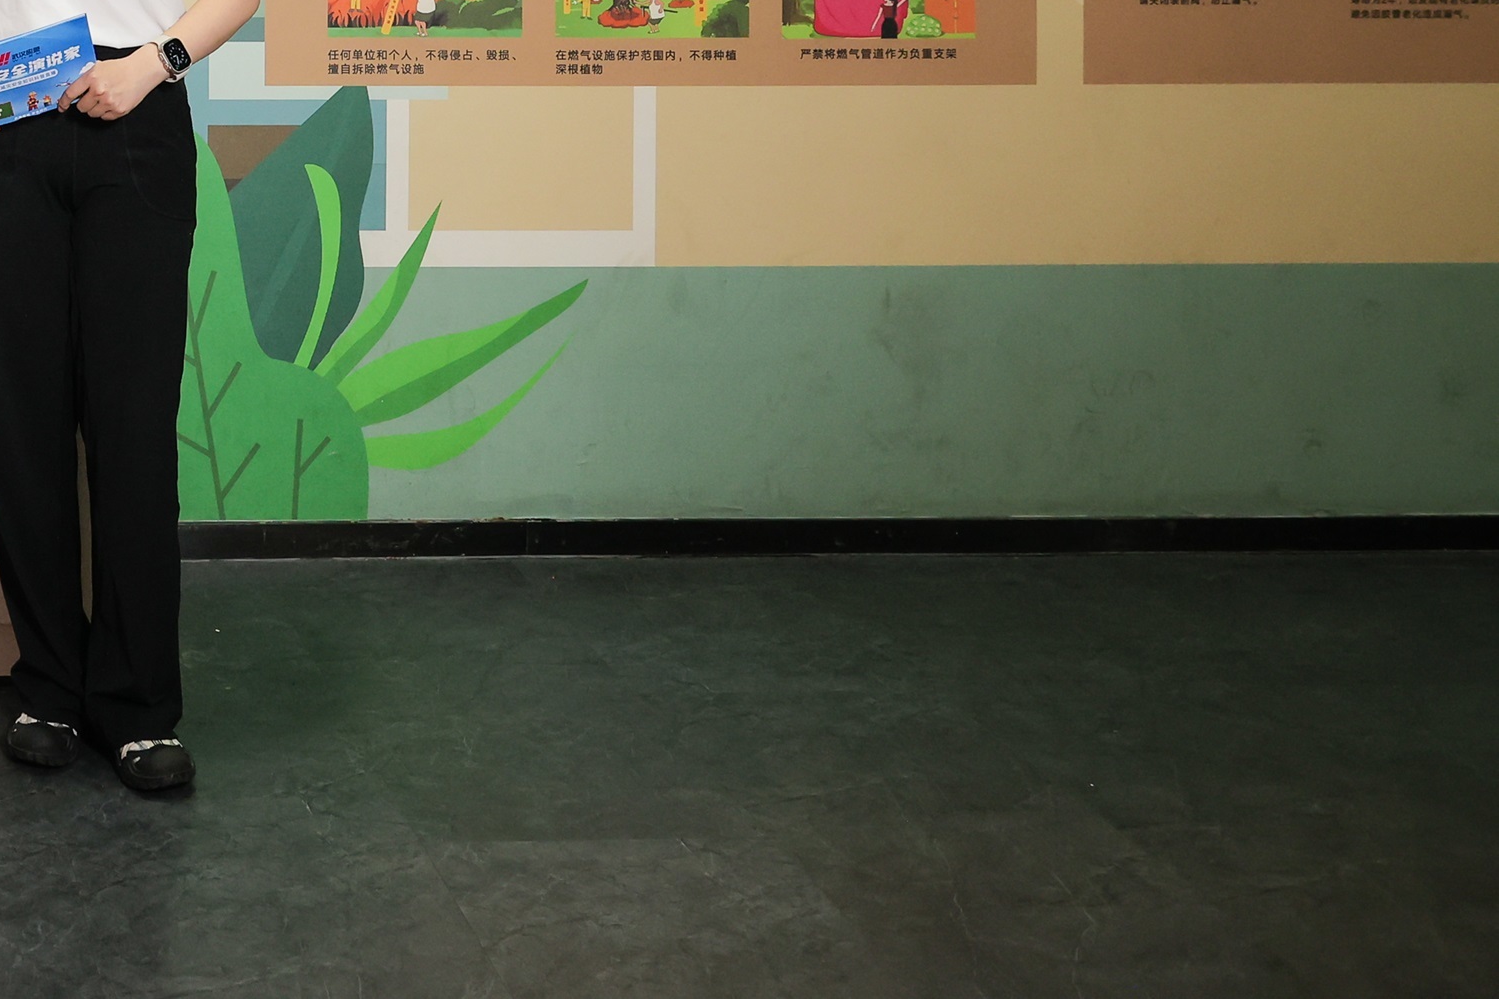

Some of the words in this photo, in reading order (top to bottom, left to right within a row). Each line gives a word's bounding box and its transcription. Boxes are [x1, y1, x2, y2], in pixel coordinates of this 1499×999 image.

[328, 49, 519, 61] 任何单位和个人，不得侵占、毁损、
[555, 49, 737, 62] 在燃气设施保护范围内，不得种植
[800, 48, 958, 60] 严禁将燃气管道作为负重支架
[328, 63, 425, 75] 擅自拆除燃气设施
[555, 63, 603, 75] 深根植物
